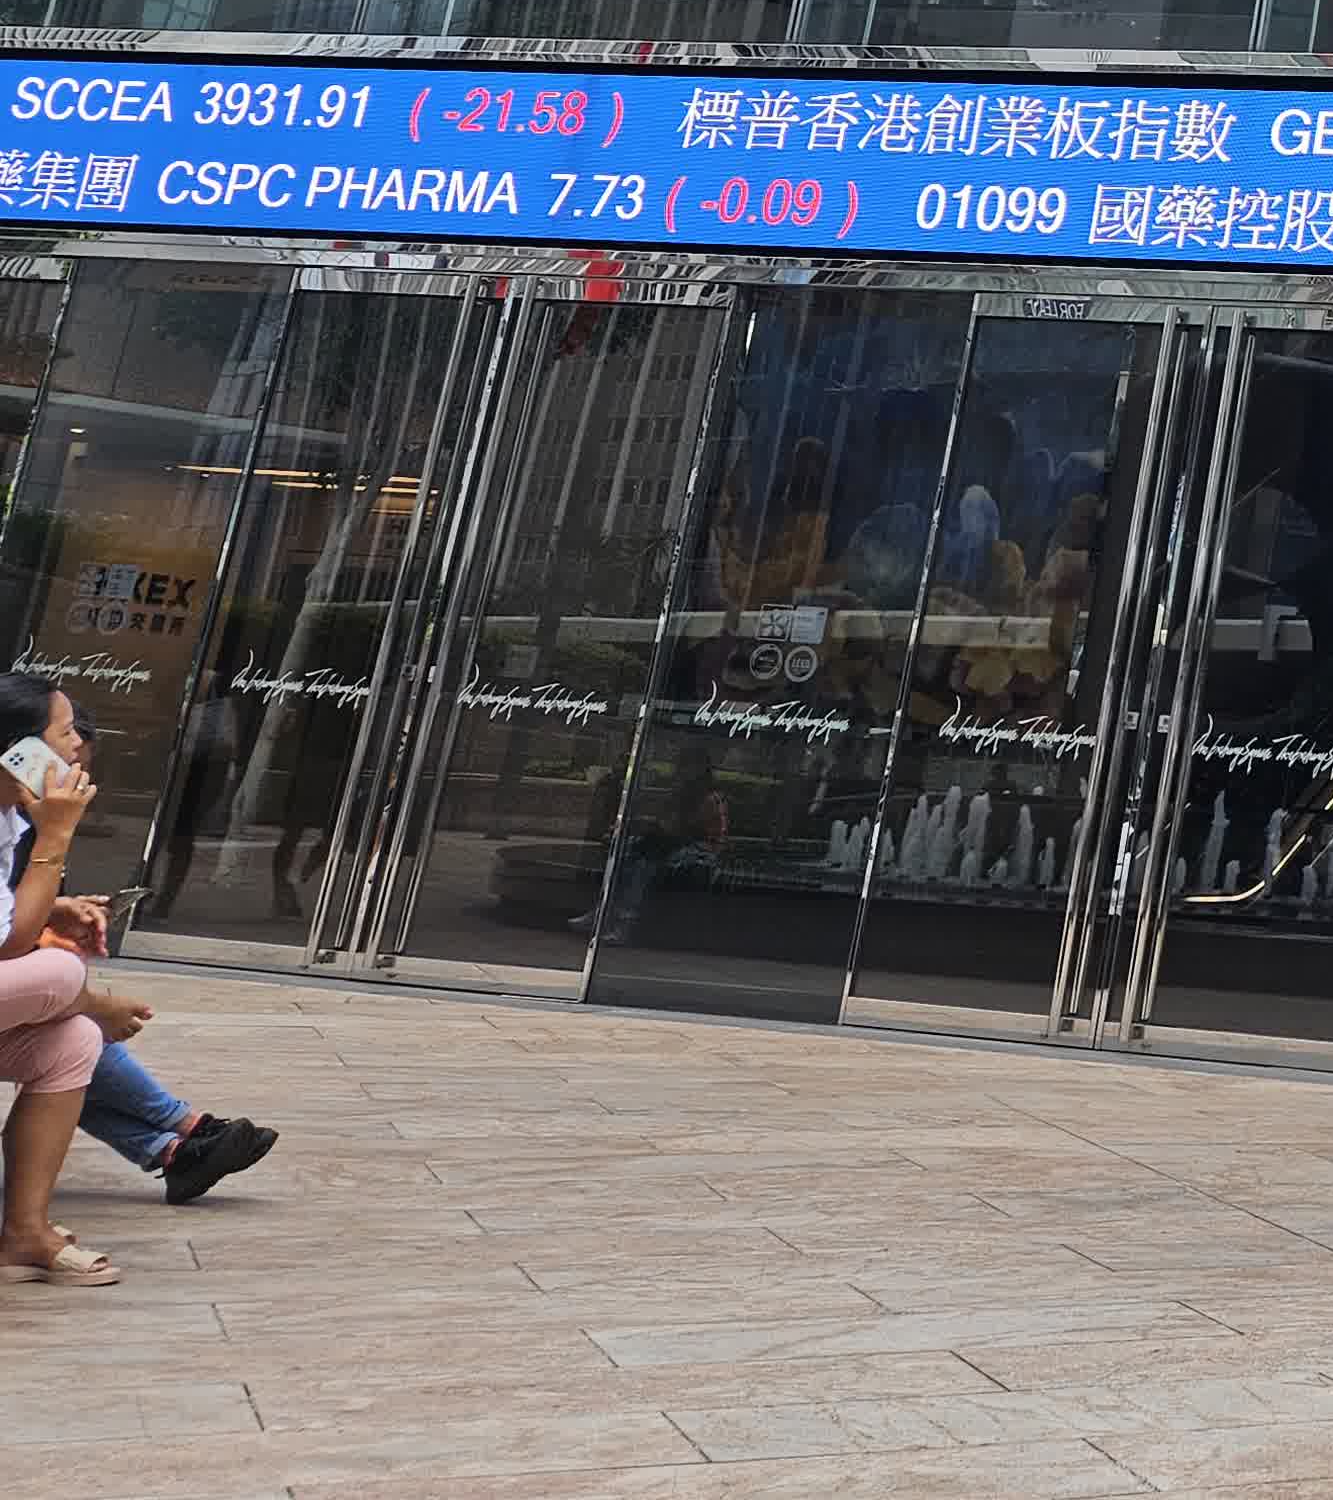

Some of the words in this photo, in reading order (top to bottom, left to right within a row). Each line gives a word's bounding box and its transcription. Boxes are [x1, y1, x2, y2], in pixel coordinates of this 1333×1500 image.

[11, 77, 172, 122] SCCEA
[194, 82, 370, 128] 3931.91
[677, 84, 1237, 163] 標普香港創業板指數
[158, 161, 296, 207] CSPC
[305, 167, 518, 214] PHARMA
[549, 174, 645, 219] 7.73
[917, 184, 1067, 233] 01099
